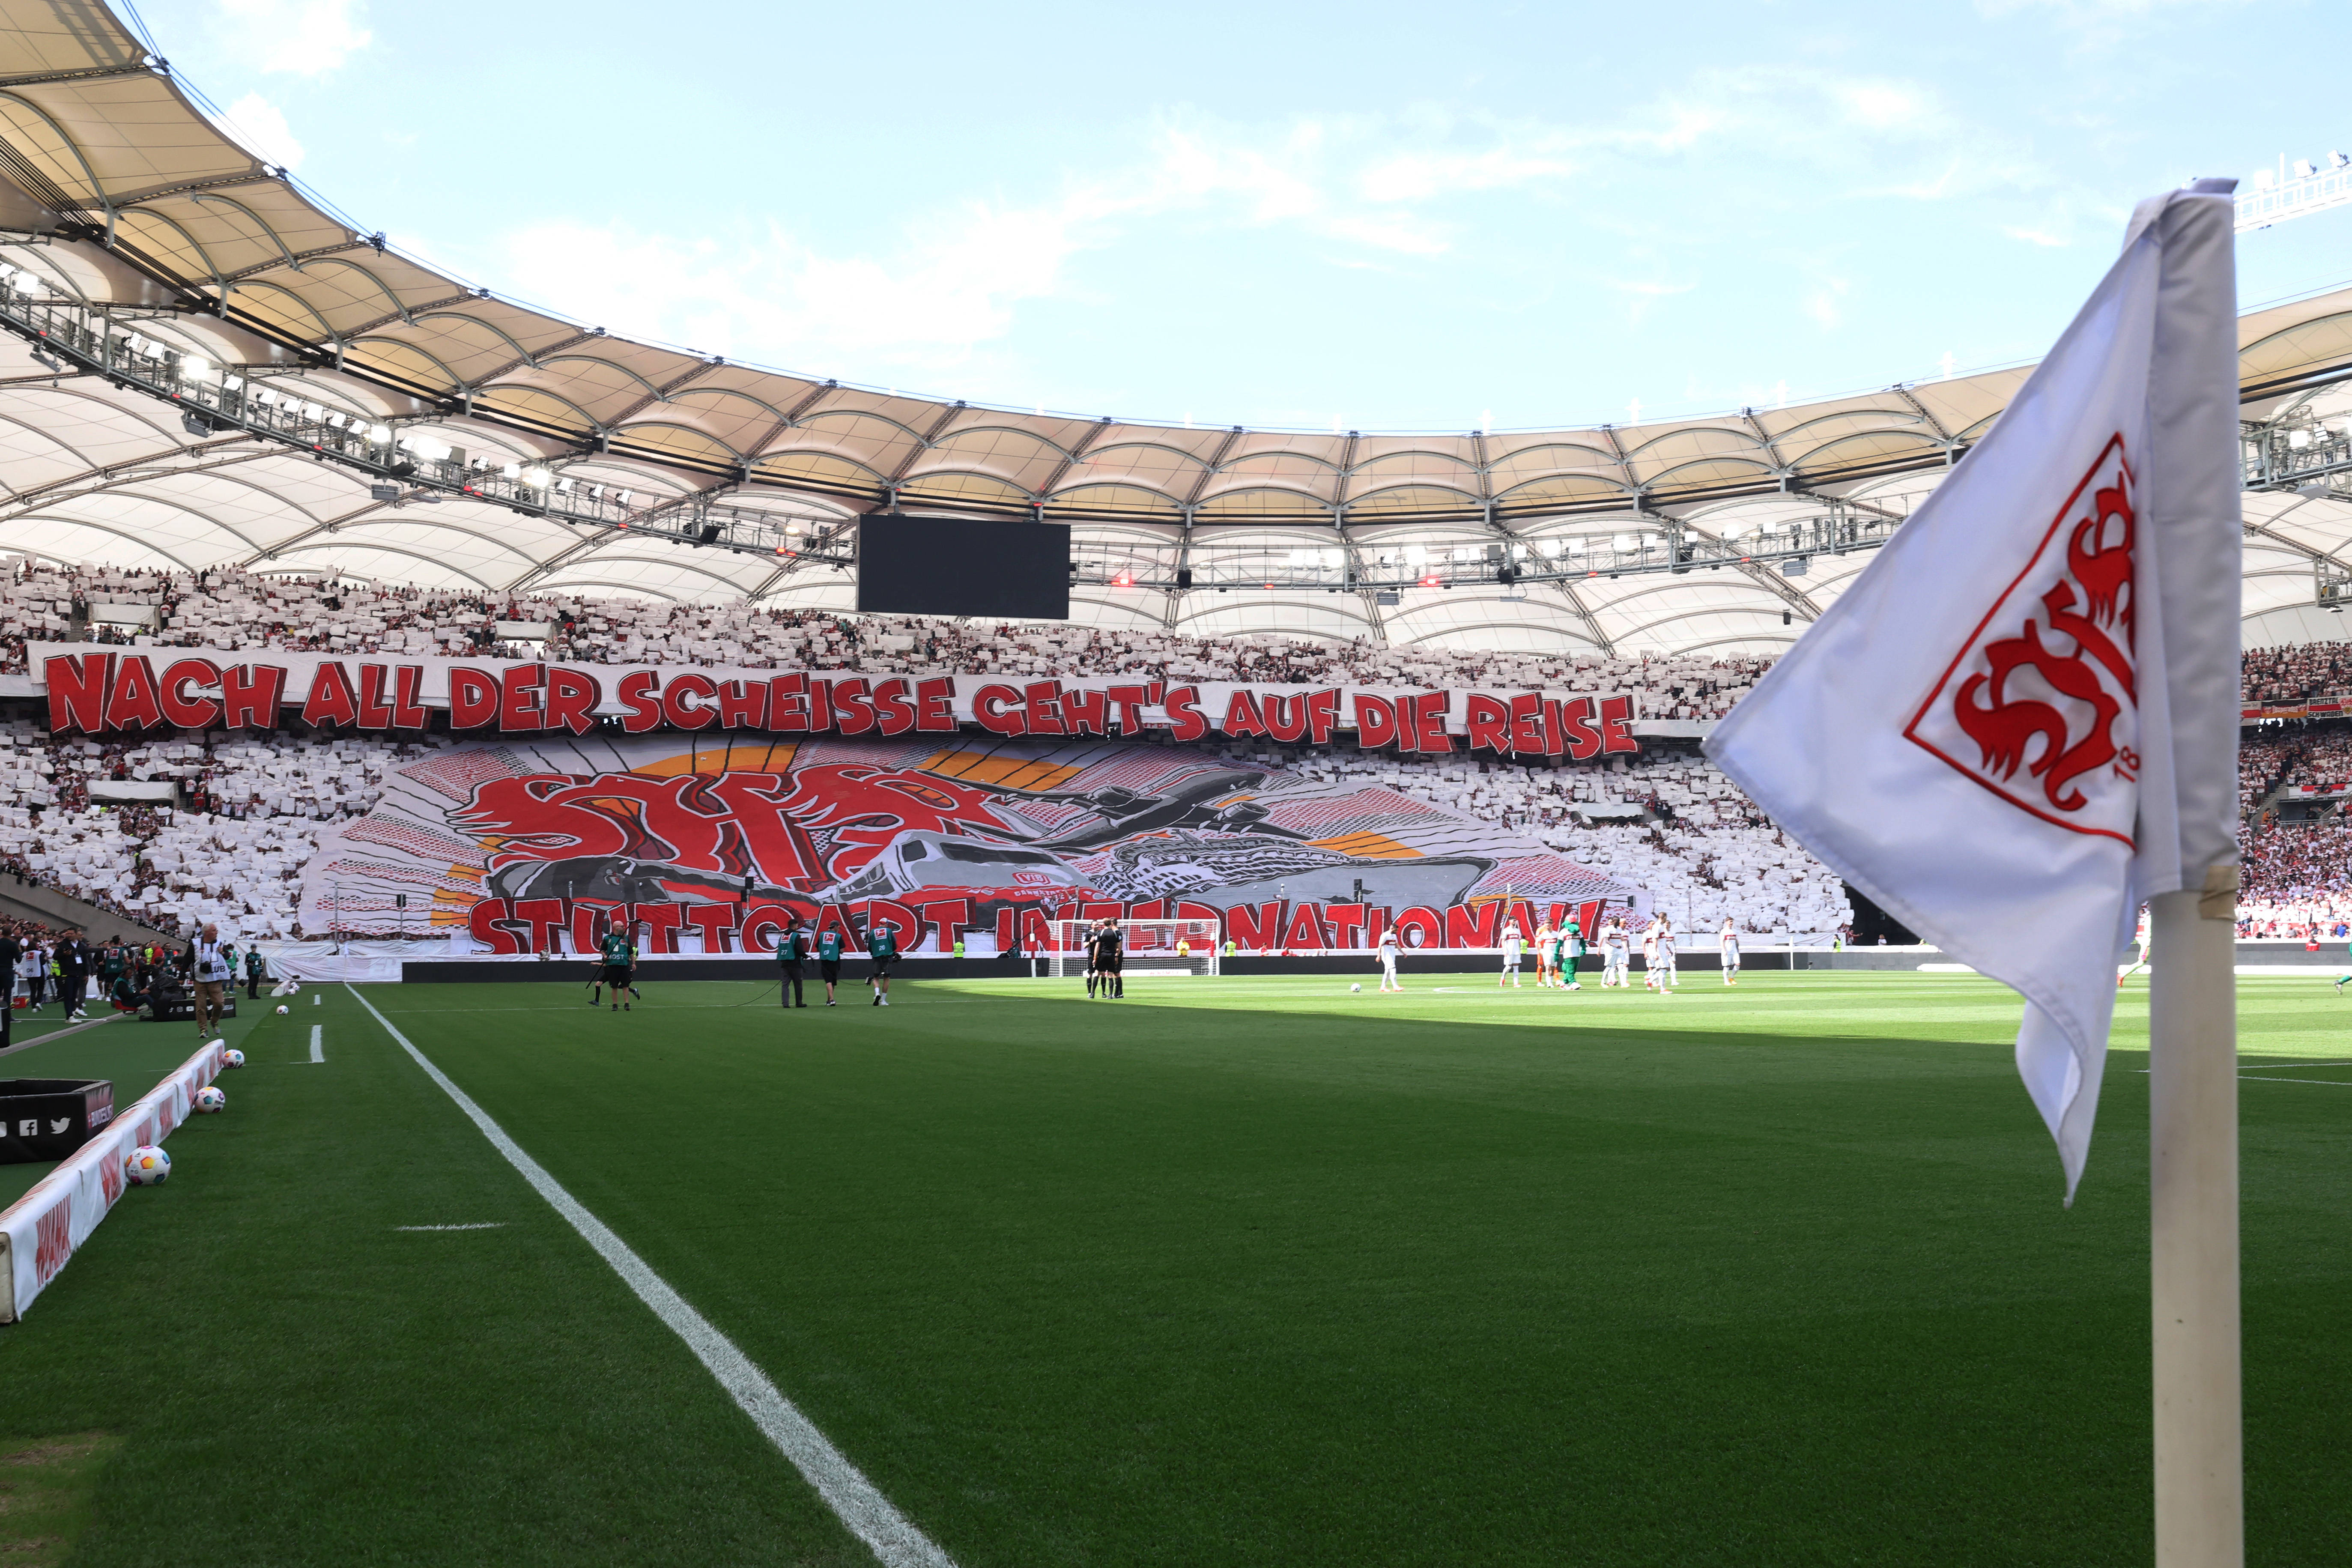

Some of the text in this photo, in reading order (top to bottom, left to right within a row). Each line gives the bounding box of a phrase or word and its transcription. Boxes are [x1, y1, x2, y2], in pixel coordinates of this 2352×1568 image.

[44, 652, 1643, 760] NACH ALL DER SCHEISSE GEHT'S AUF DIE REISE
[468, 895, 976, 955] STUTTGART
